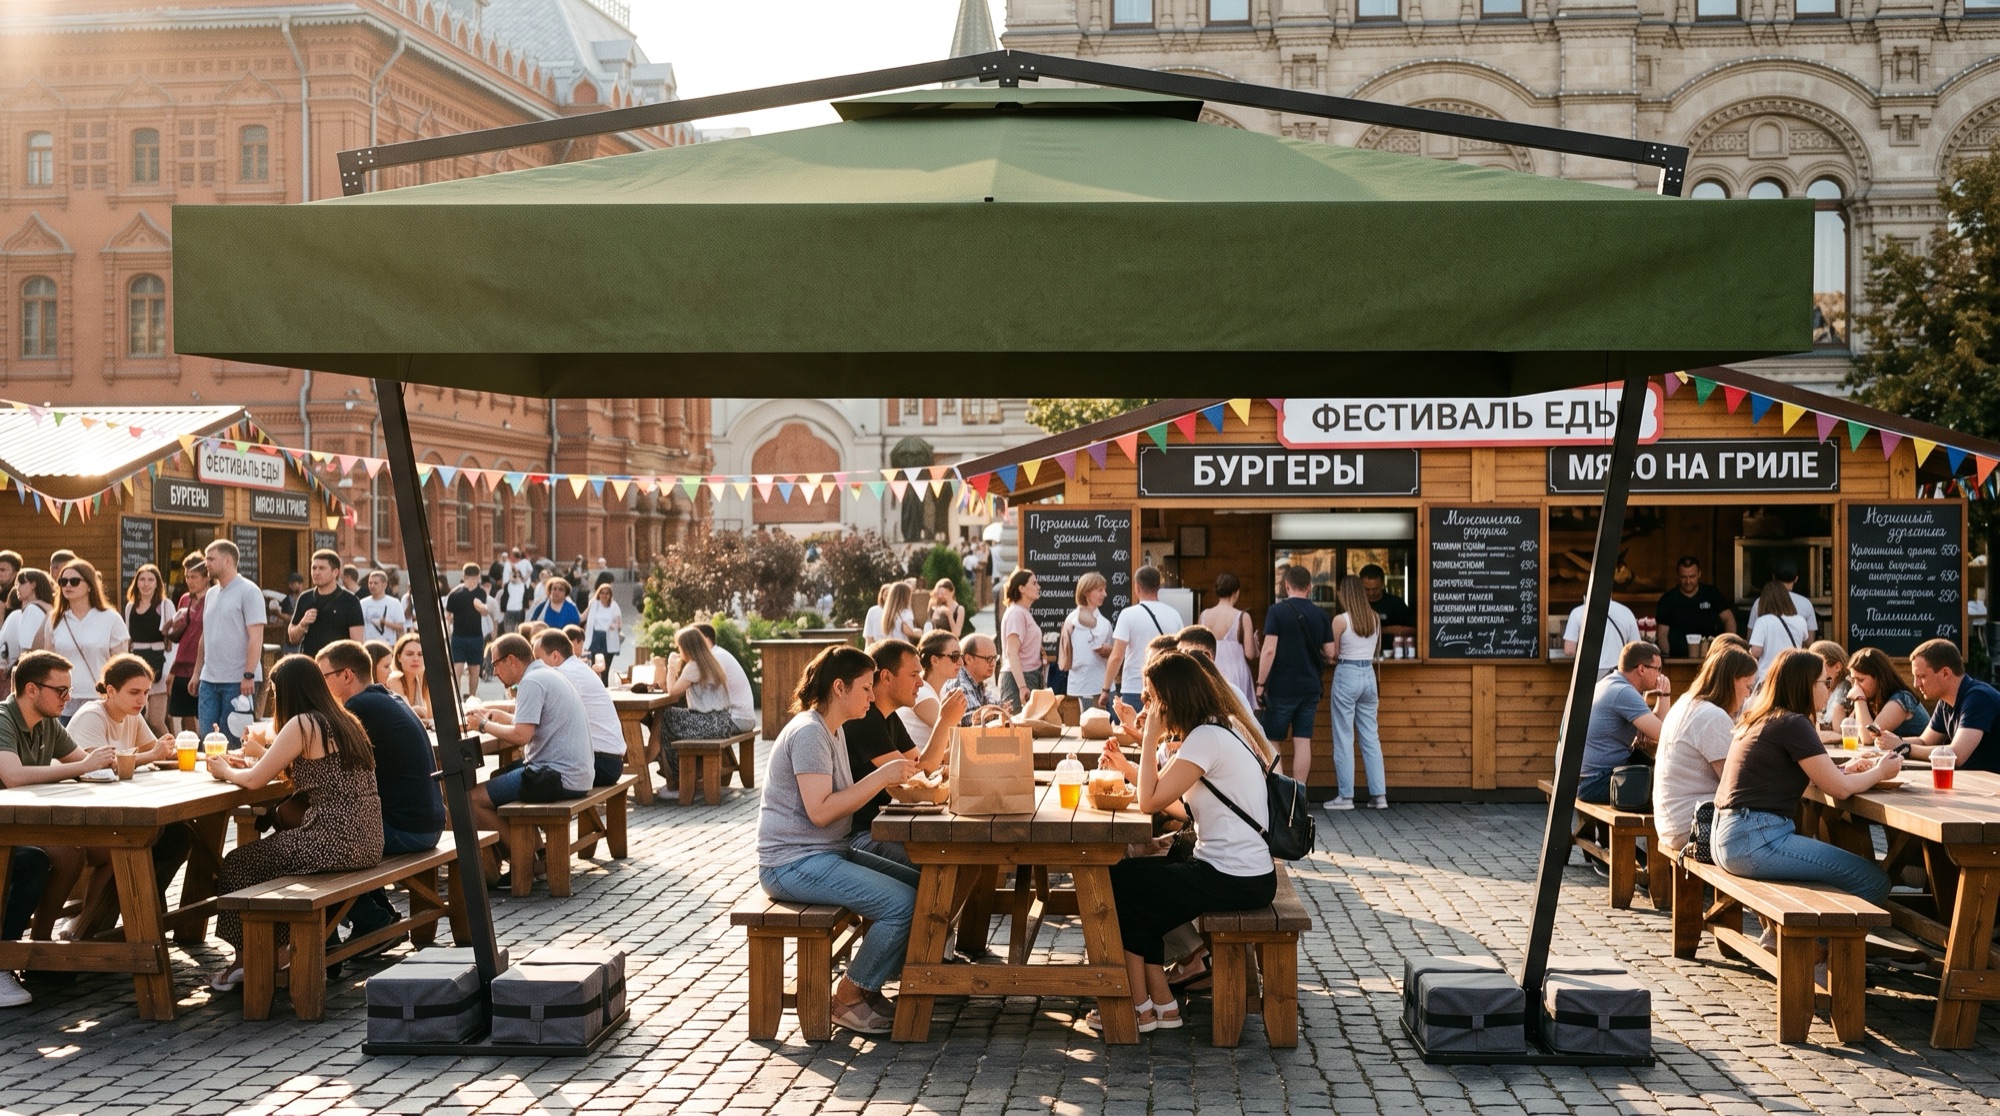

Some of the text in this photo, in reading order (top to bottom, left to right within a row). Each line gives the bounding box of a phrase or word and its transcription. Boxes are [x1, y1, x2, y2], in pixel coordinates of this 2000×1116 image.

[1312, 402, 1533, 432] ФЕСТИВАЛЬ
[205, 454, 280, 482] ФЕСТИВАЛЬ ЕДЫ
[1192, 454, 1364, 487] БУРГЕРЫ
[1568, 451, 1819, 481] МЯО НА ГРИЛЕ
[170, 484, 209, 509] БУРГЕРЫ
[255, 496, 307, 518] МЯСО НА ГРИЛЕ
